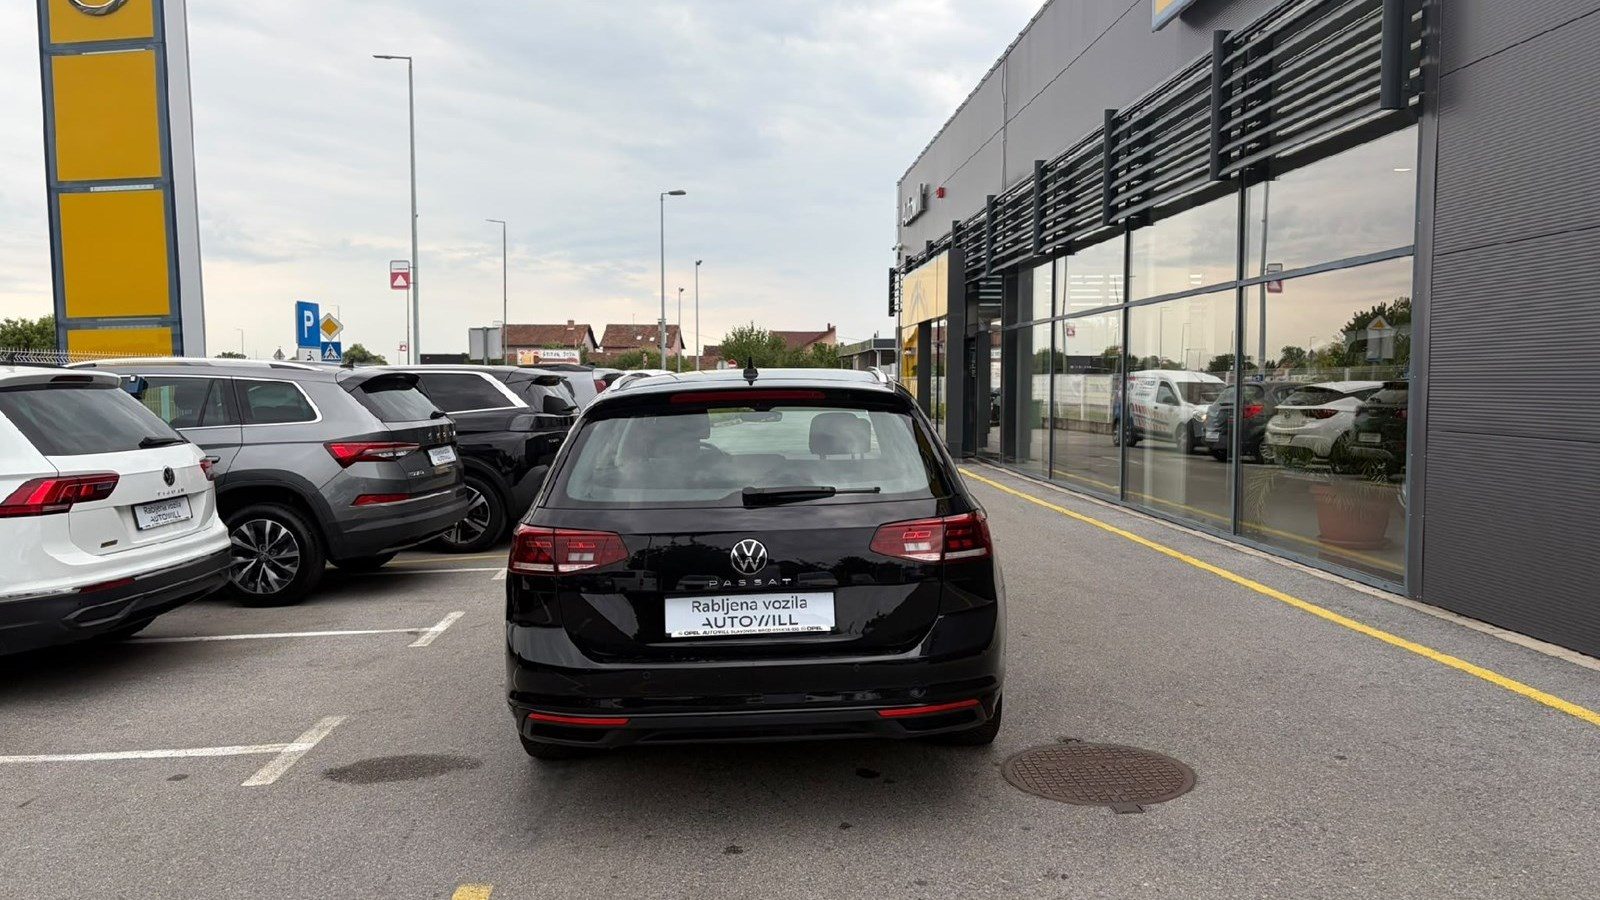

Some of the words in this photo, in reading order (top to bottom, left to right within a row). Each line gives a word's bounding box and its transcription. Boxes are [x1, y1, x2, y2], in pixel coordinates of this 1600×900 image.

[304, 310, 314, 338] P
[708, 578, 792, 588] PASSAT
[691, 598, 758, 614] Rabljena
[763, 595, 808, 611] vozila
[702, 614, 799, 629] AUTOWILL
